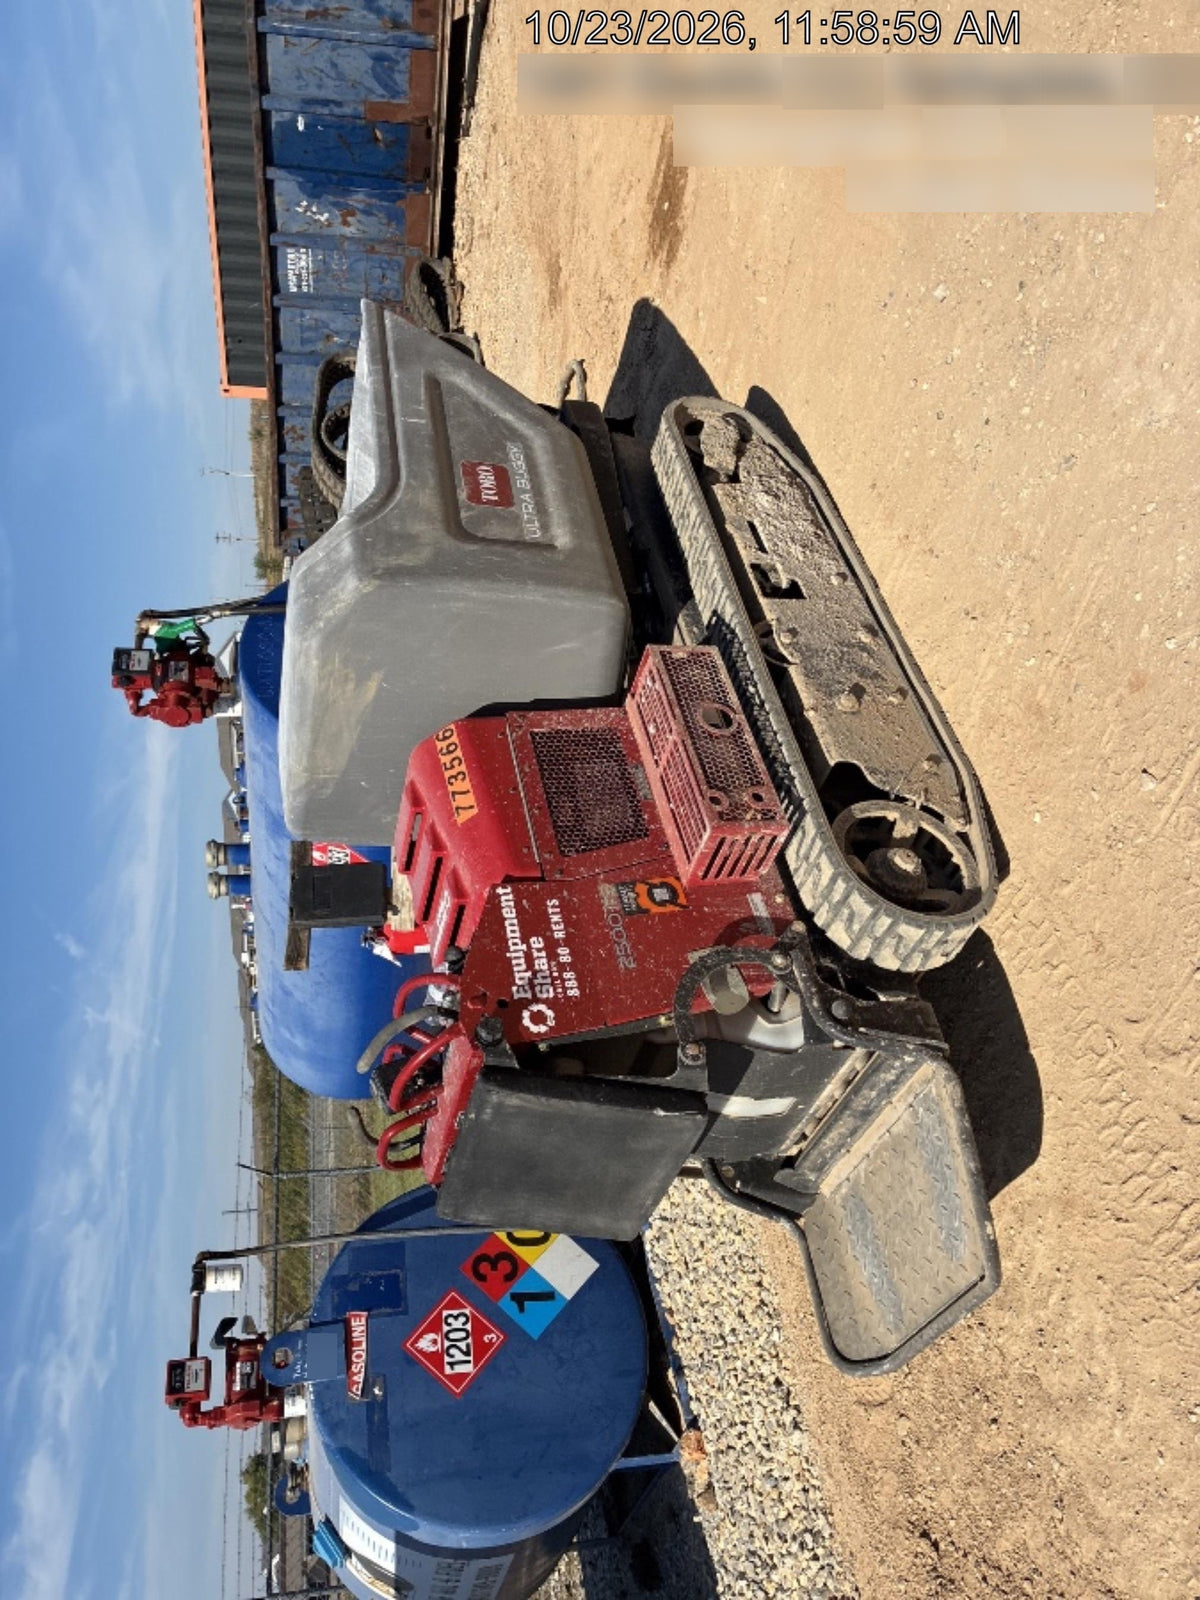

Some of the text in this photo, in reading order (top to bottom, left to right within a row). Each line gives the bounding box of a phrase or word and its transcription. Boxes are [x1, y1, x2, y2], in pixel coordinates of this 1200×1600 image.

[476, 465, 499, 502] TORO
[520, 493, 541, 538] ULTRA
[435, 727, 475, 817] 773566
[496, 885, 532, 1000] Equipment
[529, 937, 554, 999] Share
[472, 1251, 519, 1283] 3
[510, 1291, 555, 1314] 1
[351, 1316, 366, 1395] GASOLINE
[444, 1311, 471, 1371] 1203
[483, 1333, 497, 1344] 3
